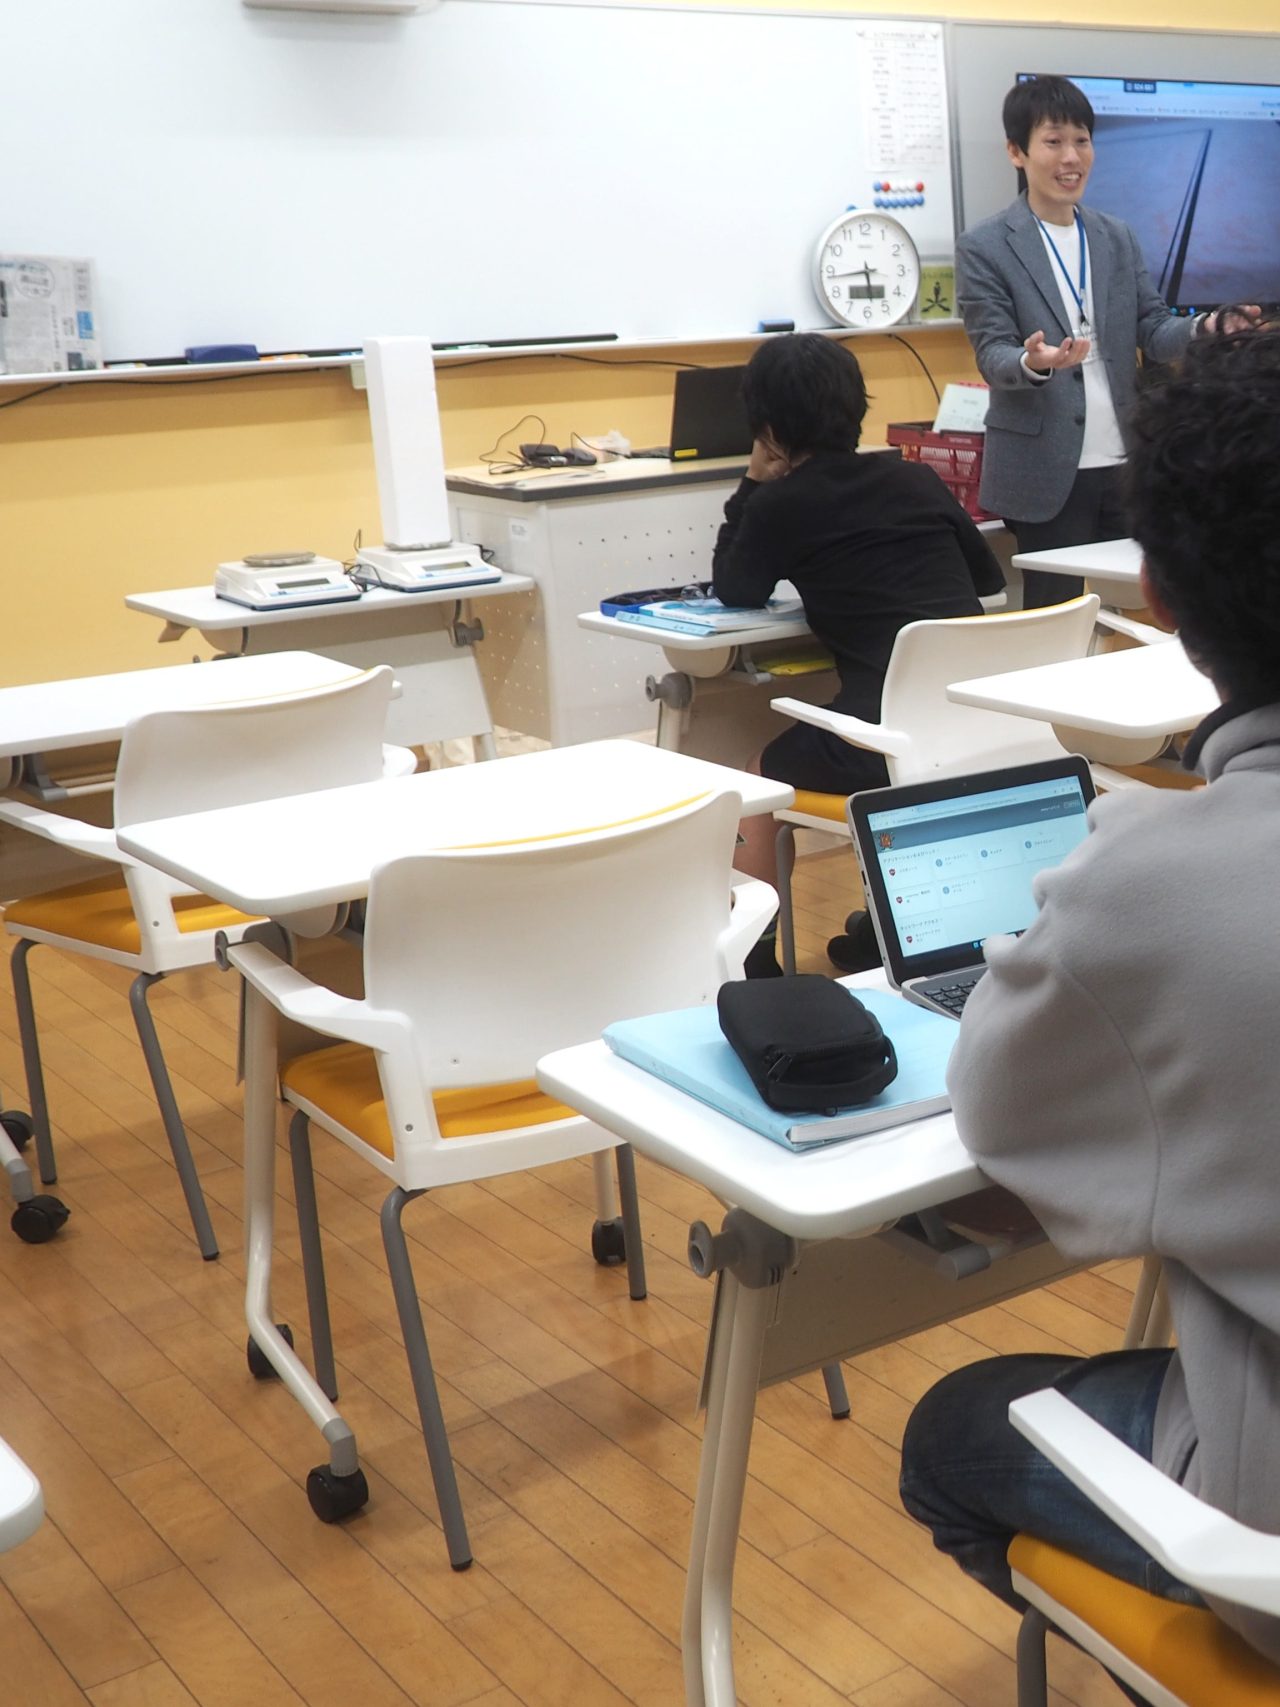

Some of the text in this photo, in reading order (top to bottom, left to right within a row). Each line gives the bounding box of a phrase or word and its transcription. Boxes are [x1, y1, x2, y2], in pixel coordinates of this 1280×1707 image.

[842, 229, 852, 241] 11
[859, 222, 871, 236] 12
[880, 229, 885, 240] 1
[830, 244, 842, 257] 10
[891, 244, 900, 257] 2
[896, 264, 905, 277] 3
[831, 285, 841, 298] 8
[892, 285, 902, 297] 4
[845, 301, 853, 313] 7
[863, 306, 872, 319] 6
[880, 300, 890, 313] 5
